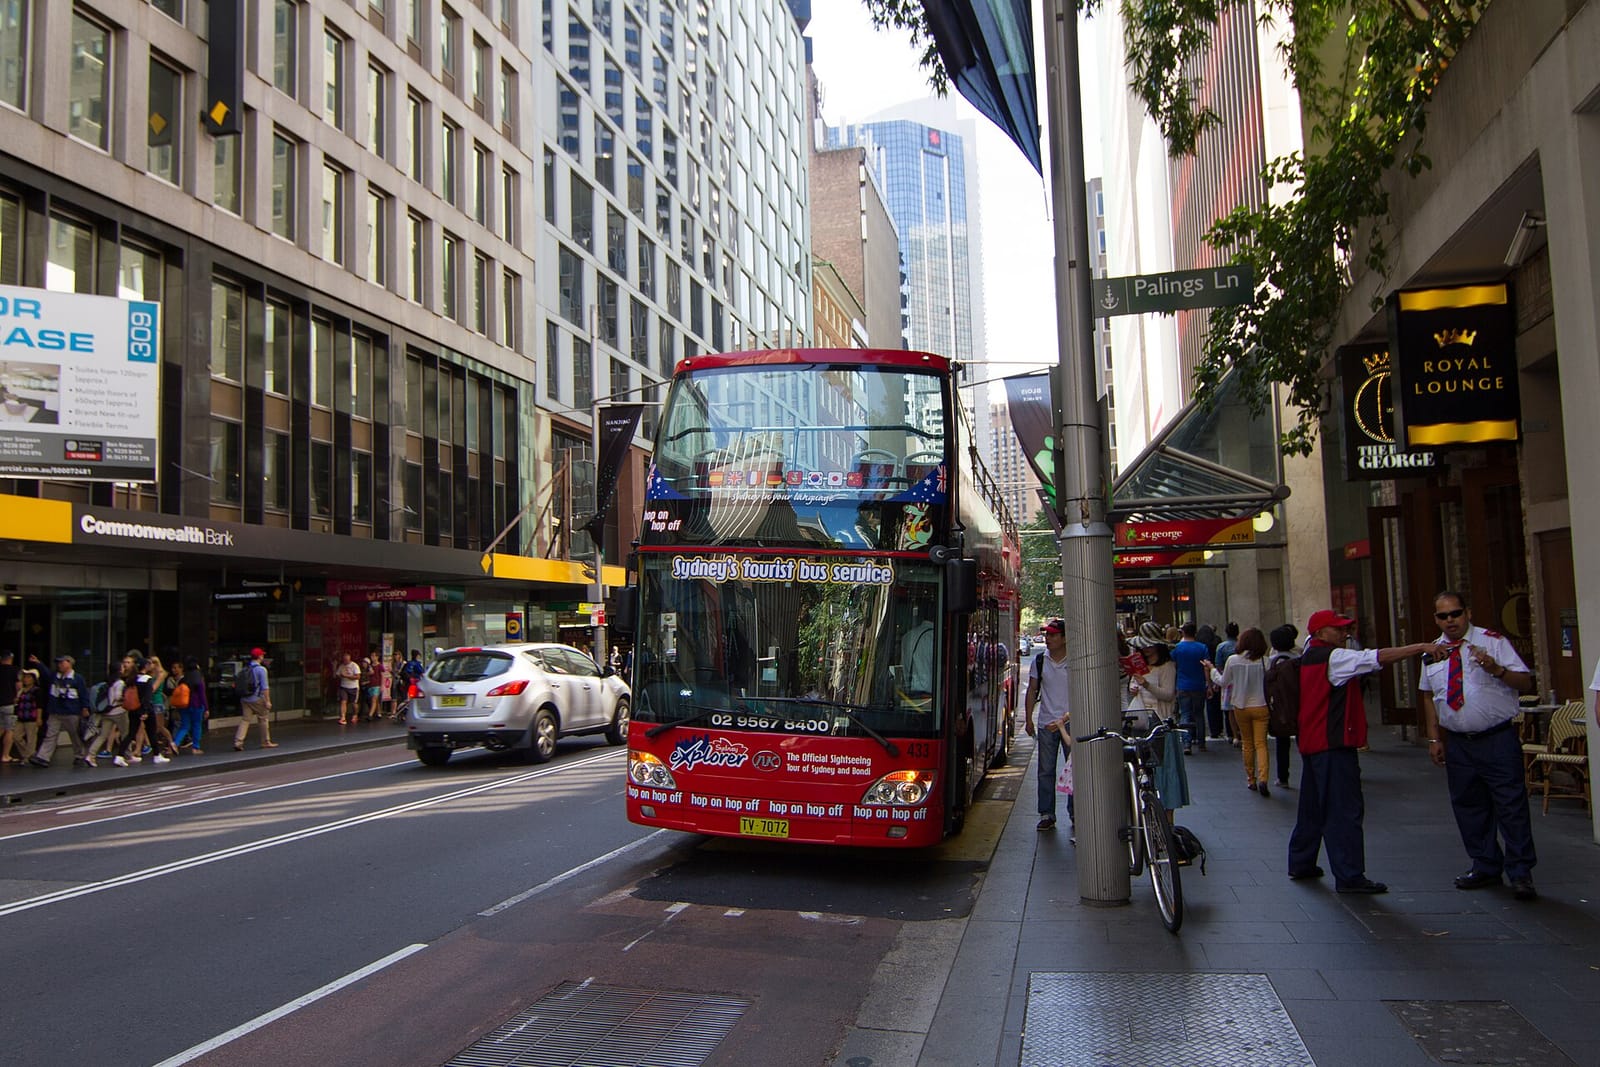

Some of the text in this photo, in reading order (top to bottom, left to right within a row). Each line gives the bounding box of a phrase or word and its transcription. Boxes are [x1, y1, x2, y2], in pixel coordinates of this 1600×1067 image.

[1135, 271, 1239, 297] Palings Ln
[0, 327, 95, 353] ASE
[130, 311, 151, 357] 309
[1424, 356, 1491, 373] ROYAL
[1415, 376, 1504, 395] LOUNGE
[1357, 445, 1388, 457] THE
[1358, 452, 1435, 470] GEORGE
[794, 493, 834, 505] language
[644, 510, 668, 521] hop on
[651, 519, 681, 532] hop off
[1141, 530, 1249, 541] st.george ATM
[673, 557, 739, 581] Sydney's
[742, 557, 796, 580] tourist
[799, 560, 829, 581] bus
[712, 714, 829, 732] 02 9567 8400
[907, 743, 929, 758] 433
[786, 752, 872, 767] The Official Sightseeing
[786, 763, 871, 776] Tour of Sydney and Bondi
[628, 785, 683, 804] hop on hop off
[691, 793, 760, 811] hop on hop off
[769, 800, 844, 817] hop on hop off
[853, 805, 928, 821] hop on hop off
